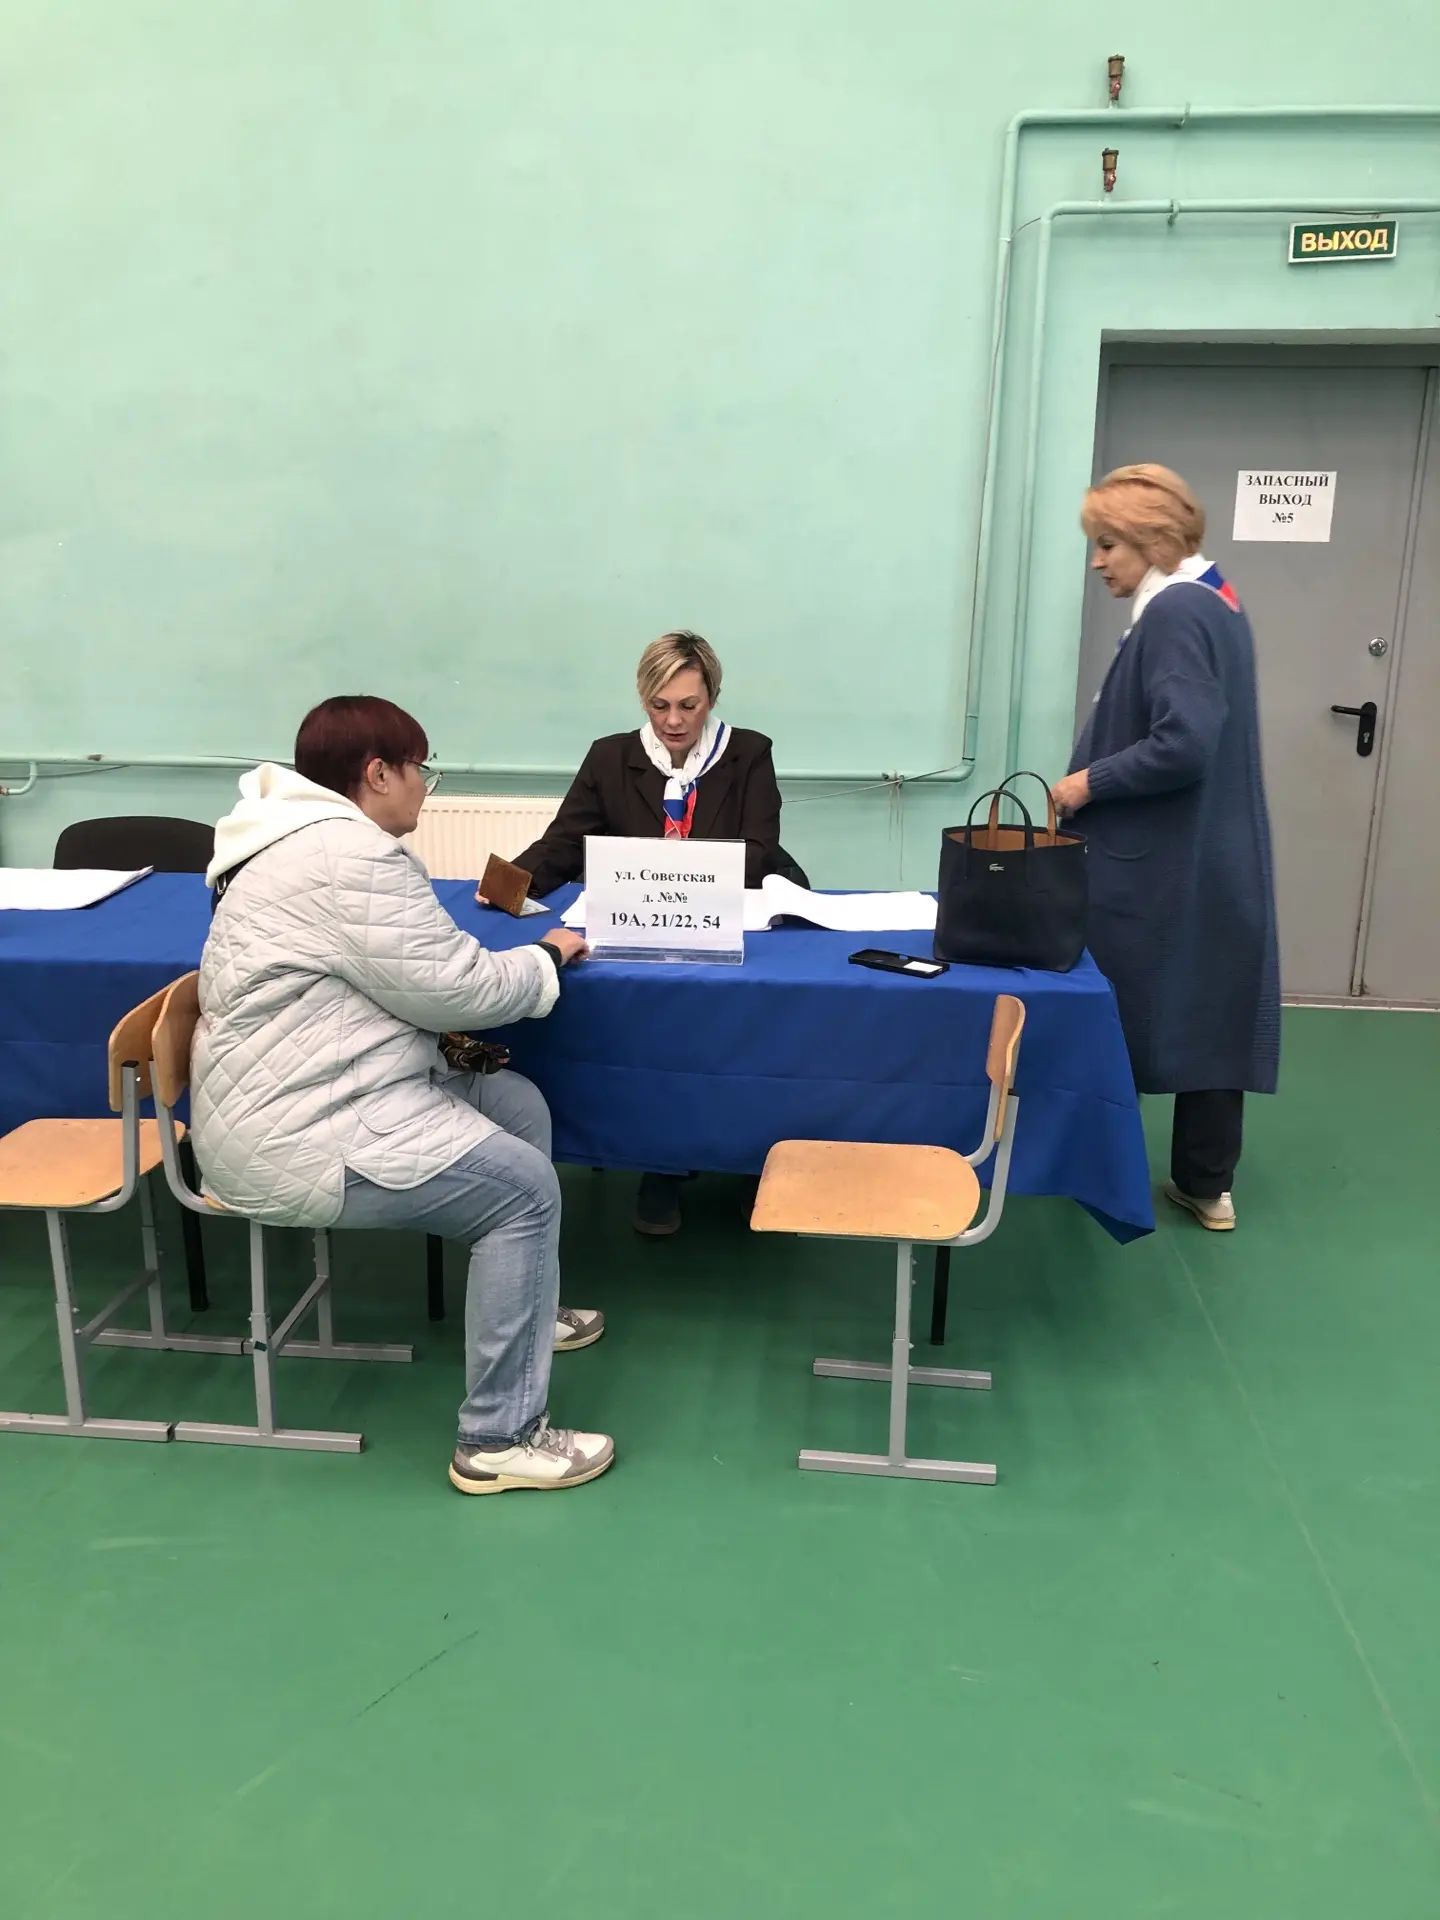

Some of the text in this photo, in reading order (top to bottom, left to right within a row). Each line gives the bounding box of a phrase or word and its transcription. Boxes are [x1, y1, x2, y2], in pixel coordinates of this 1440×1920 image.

[1301, 229, 1388, 252] ВЫХОД
[1246, 474, 1329, 487] ЗАПАСНЫЙ
[1259, 493, 1312, 507] ВЫХОД
[1272, 512, 1294, 523] №5
[614, 869, 716, 883] ул. Советская
[642, 891, 688, 904] д. №№
[610, 912, 721, 930] 19А, 21/22, 54
